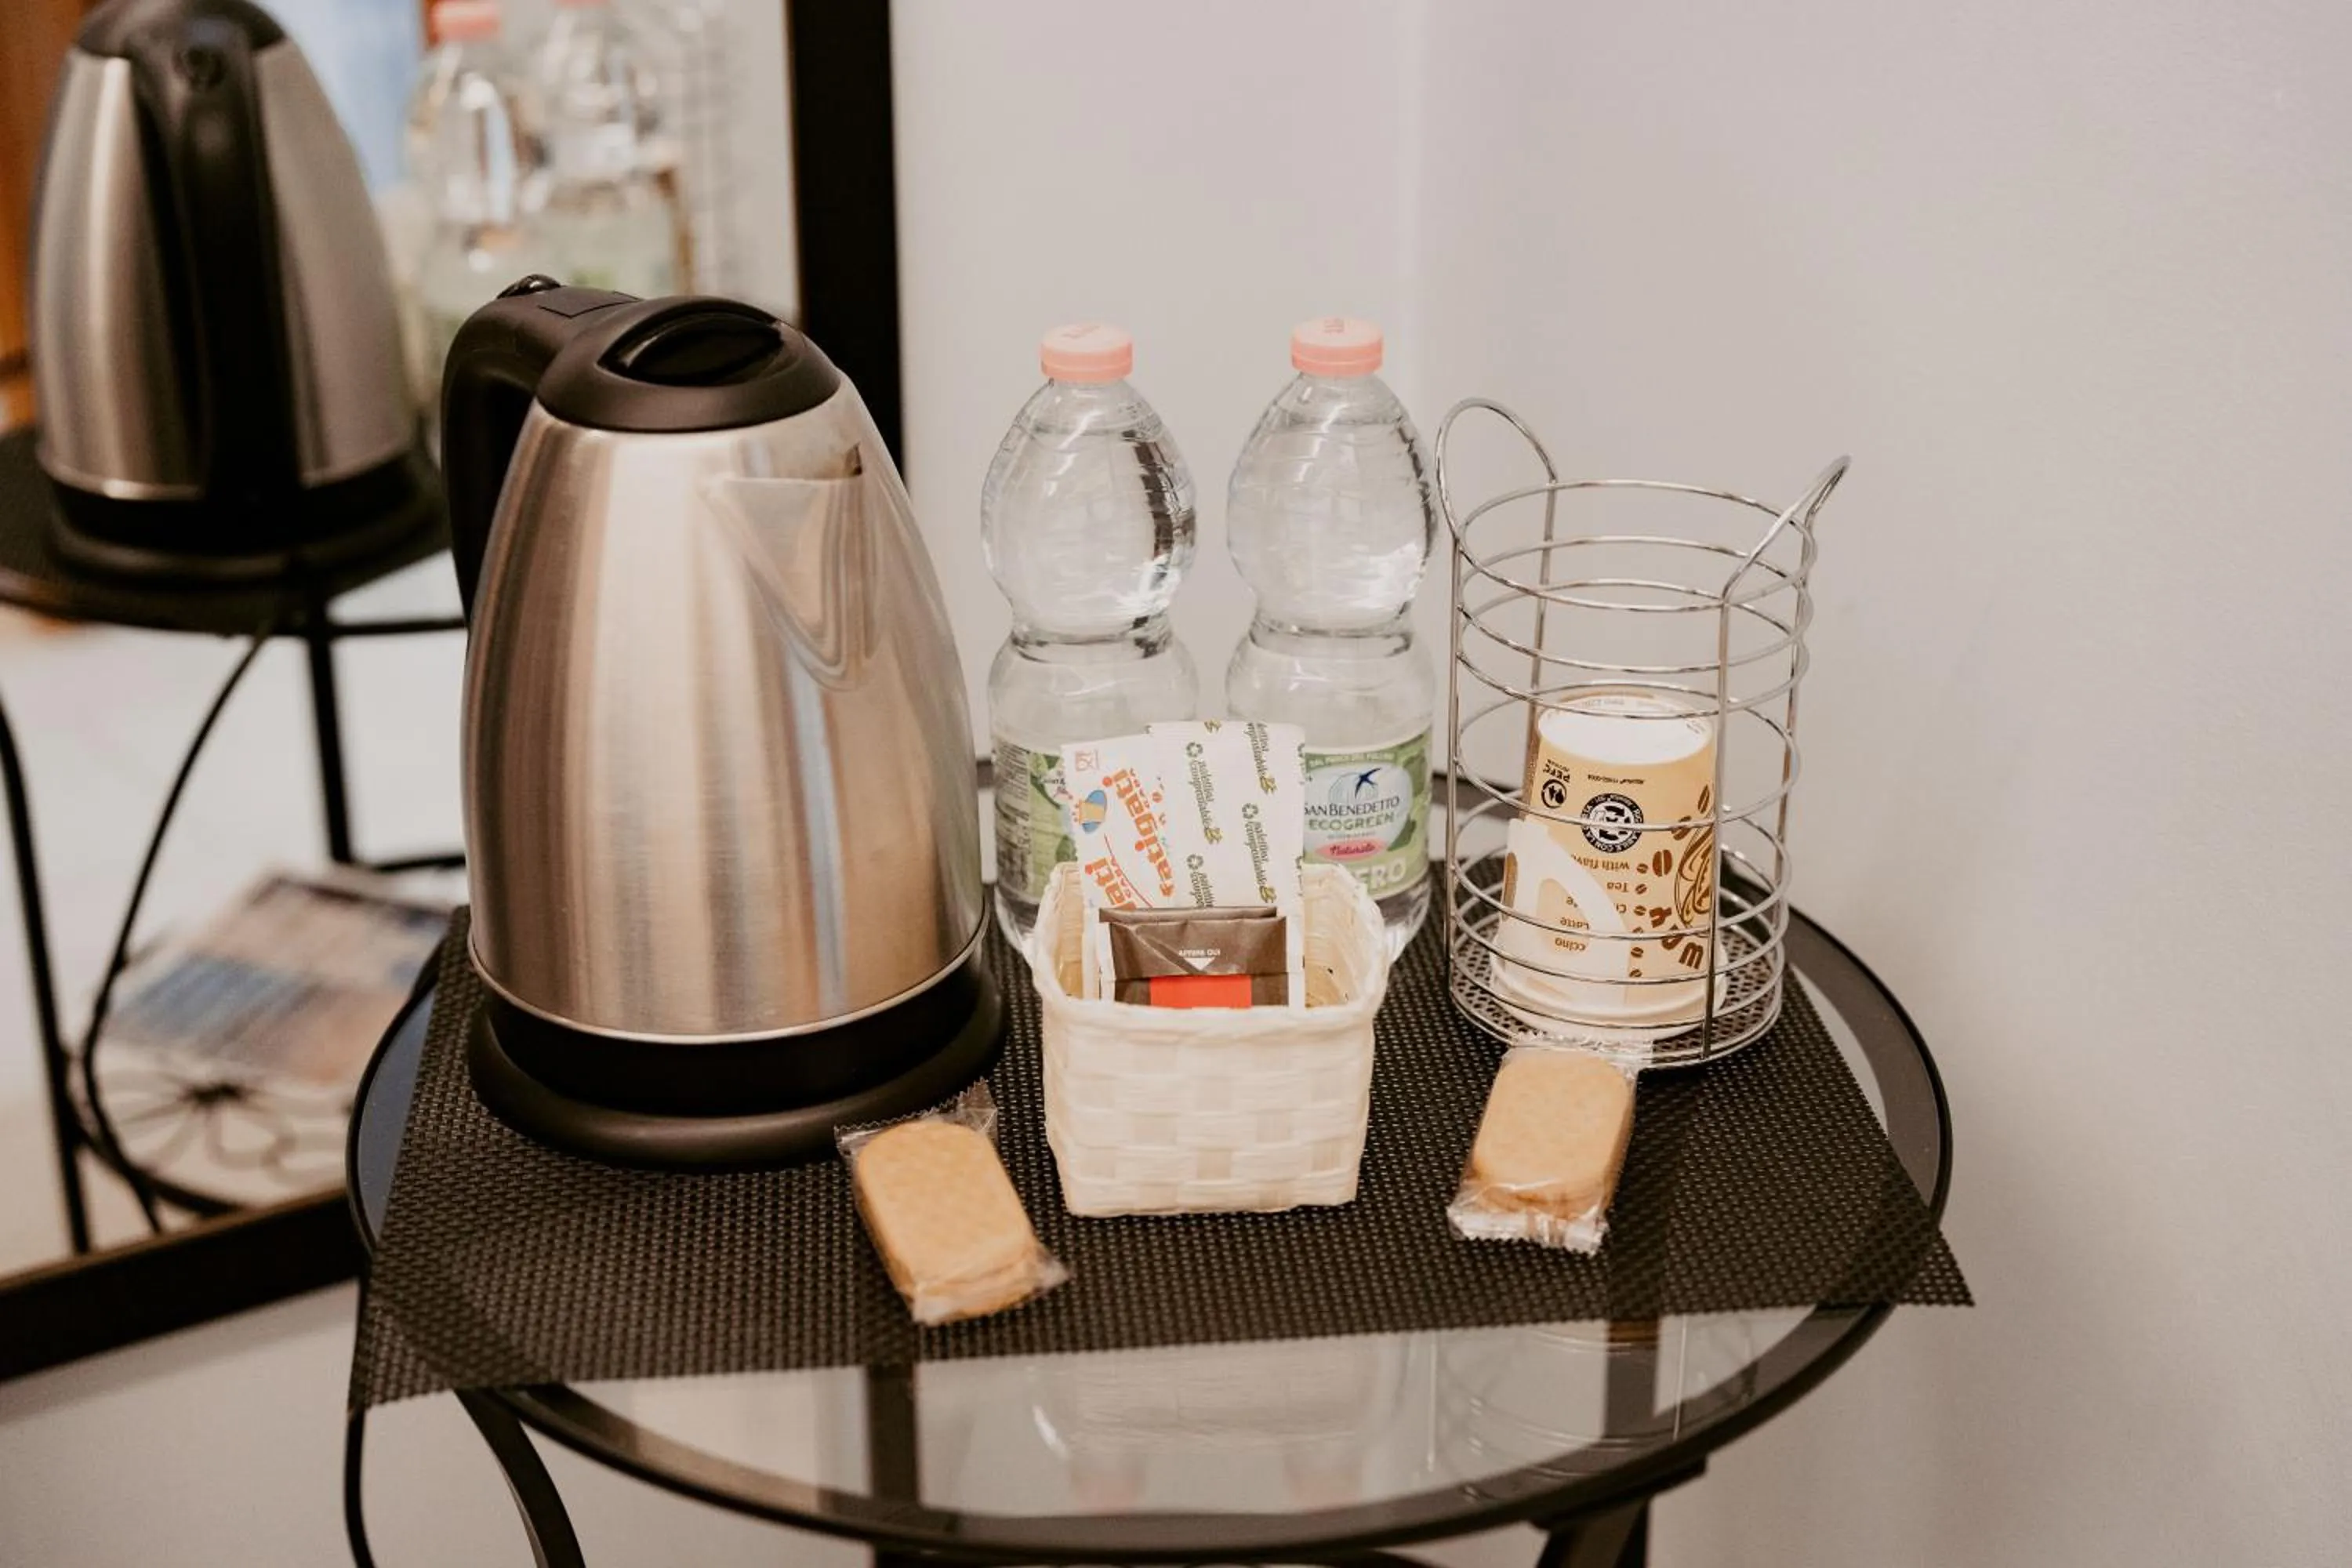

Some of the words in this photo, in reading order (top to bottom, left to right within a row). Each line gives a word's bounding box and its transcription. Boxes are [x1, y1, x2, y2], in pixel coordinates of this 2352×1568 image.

[1543, 764, 1570, 782] PEFC
[1329, 796, 1400, 817] BENEDETTO
[1309, 812, 1395, 830] ECOGREEN
[1601, 859, 1630, 872] with
[1606, 882, 1629, 893] Tea
[1555, 937, 1587, 952] ccino
